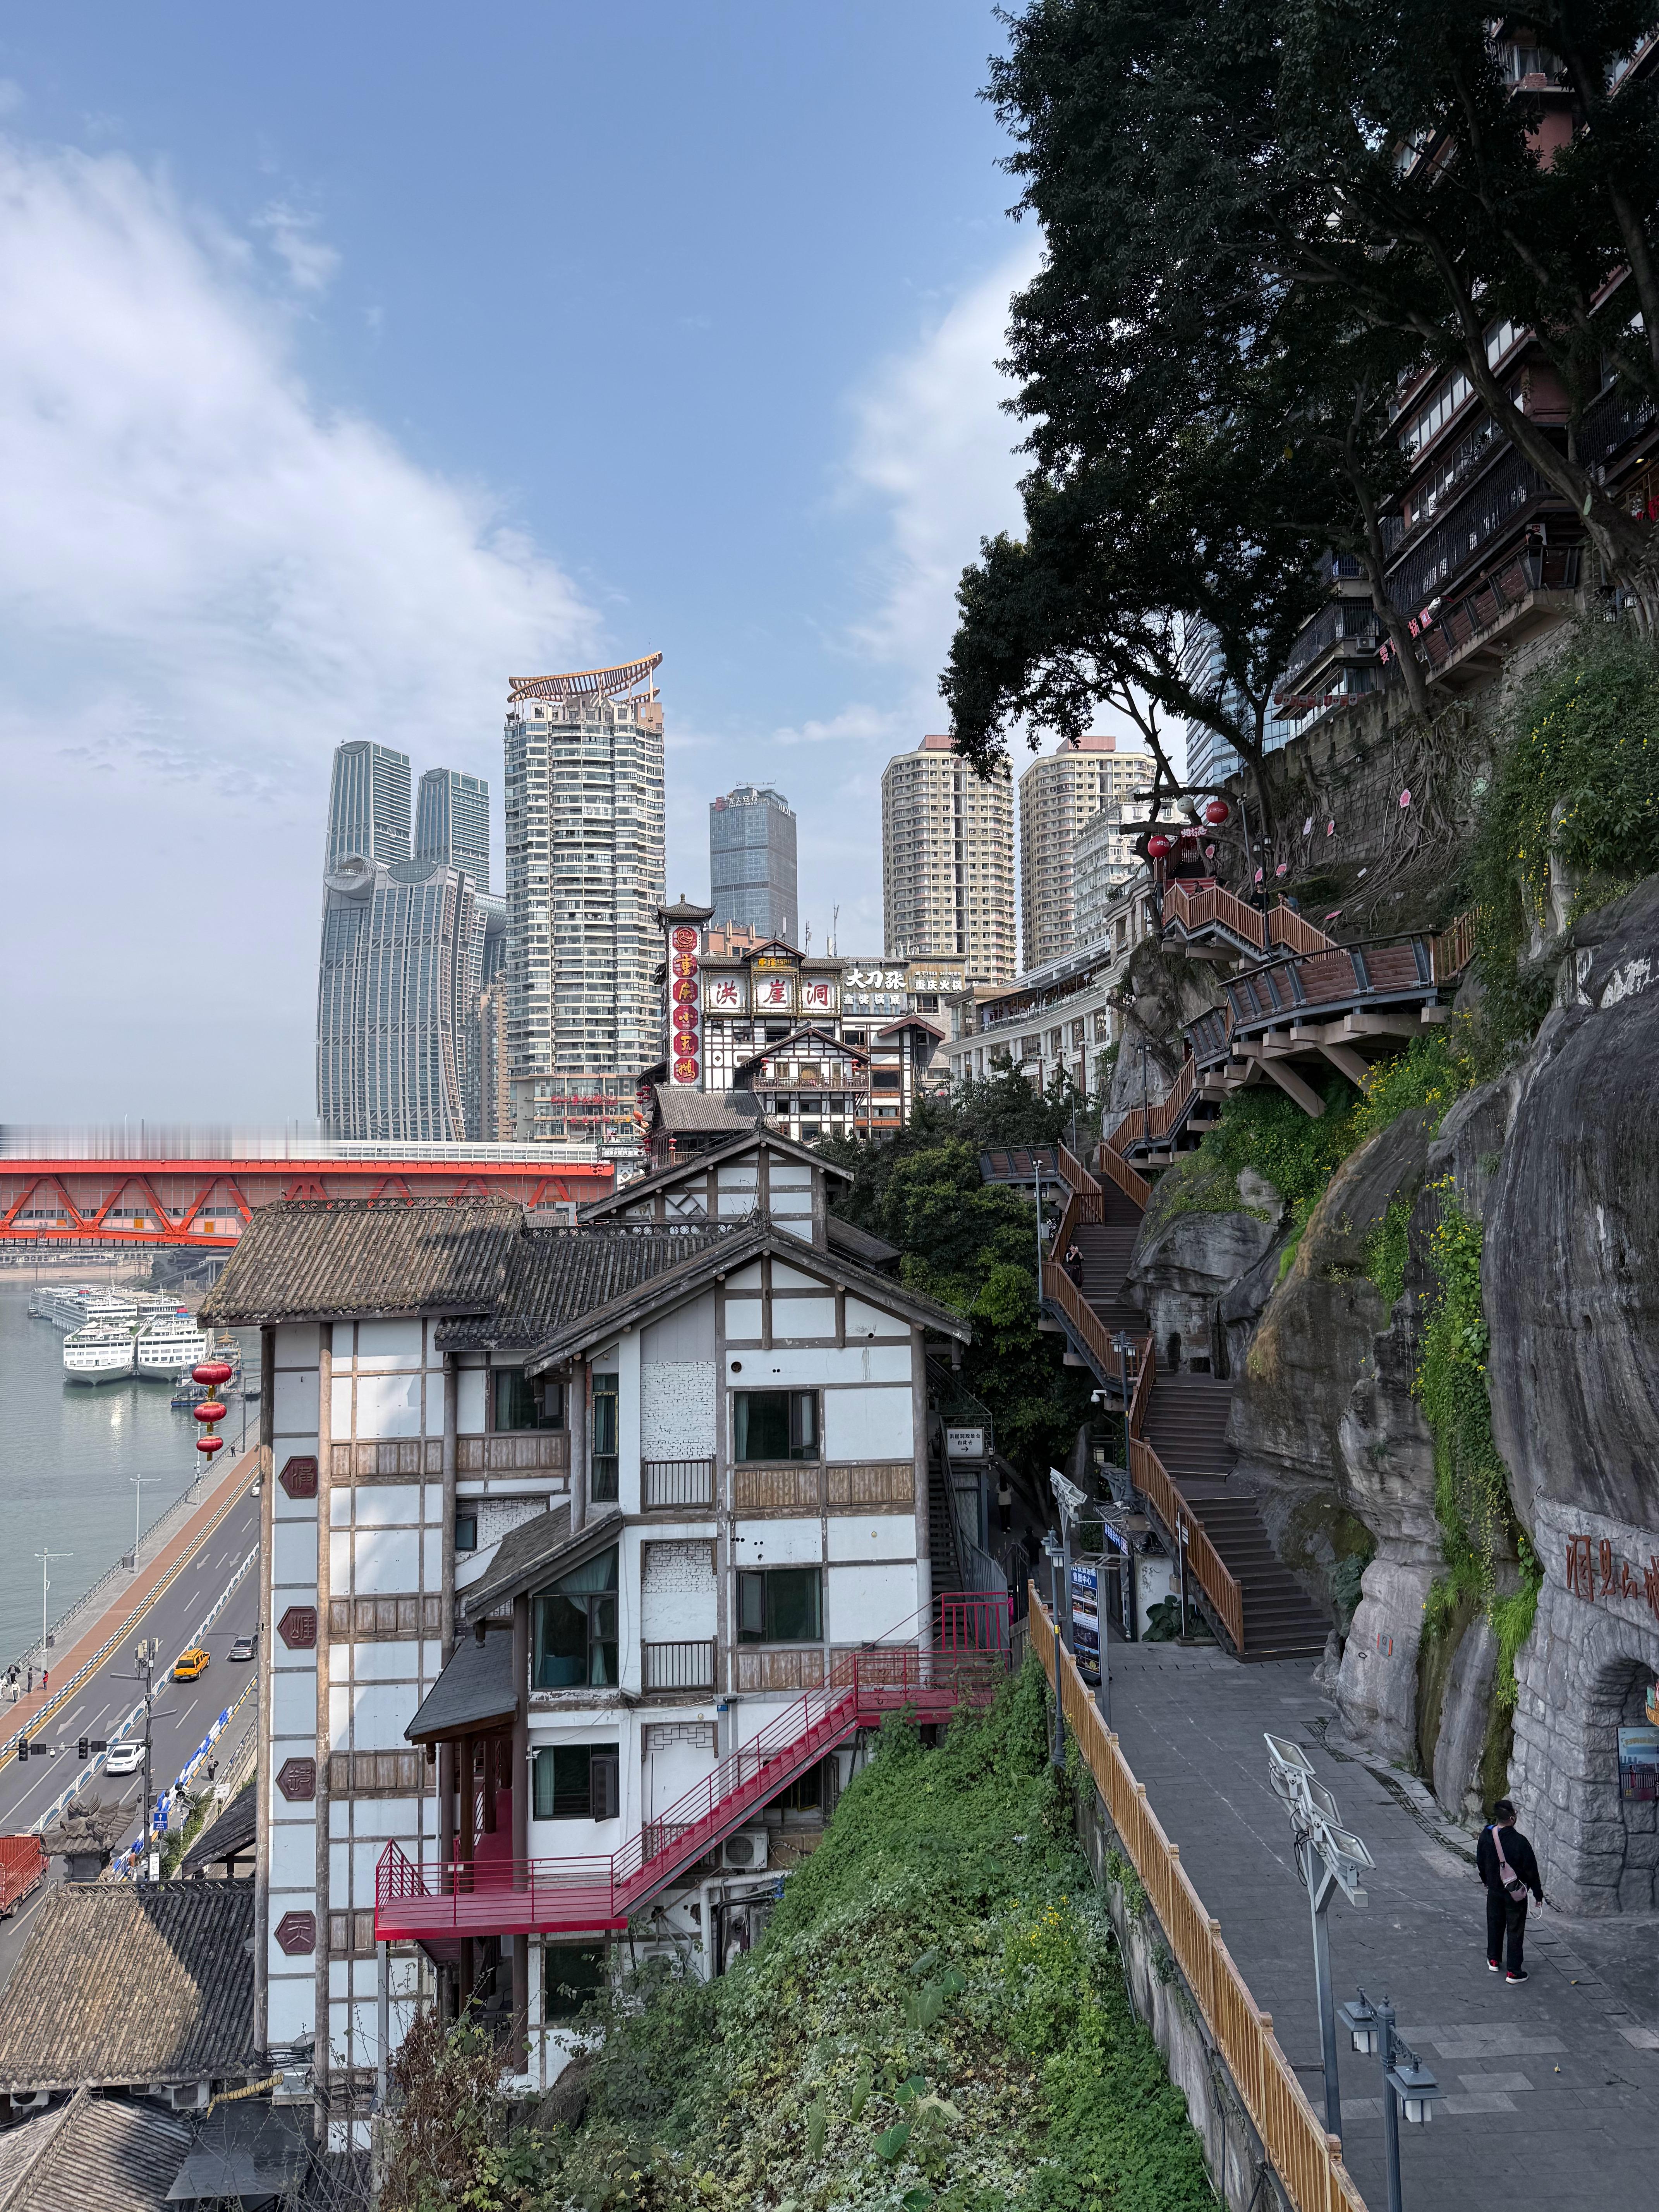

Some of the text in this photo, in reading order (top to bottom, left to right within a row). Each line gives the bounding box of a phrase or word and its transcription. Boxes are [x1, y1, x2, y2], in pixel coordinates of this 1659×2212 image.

[845, 969, 907, 990] 大刀张
[915, 980, 962, 991] 重庆火锅
[717, 979, 828, 1006] 洪崖洞
[1073, 1571, 1092, 1585] 售票中心
